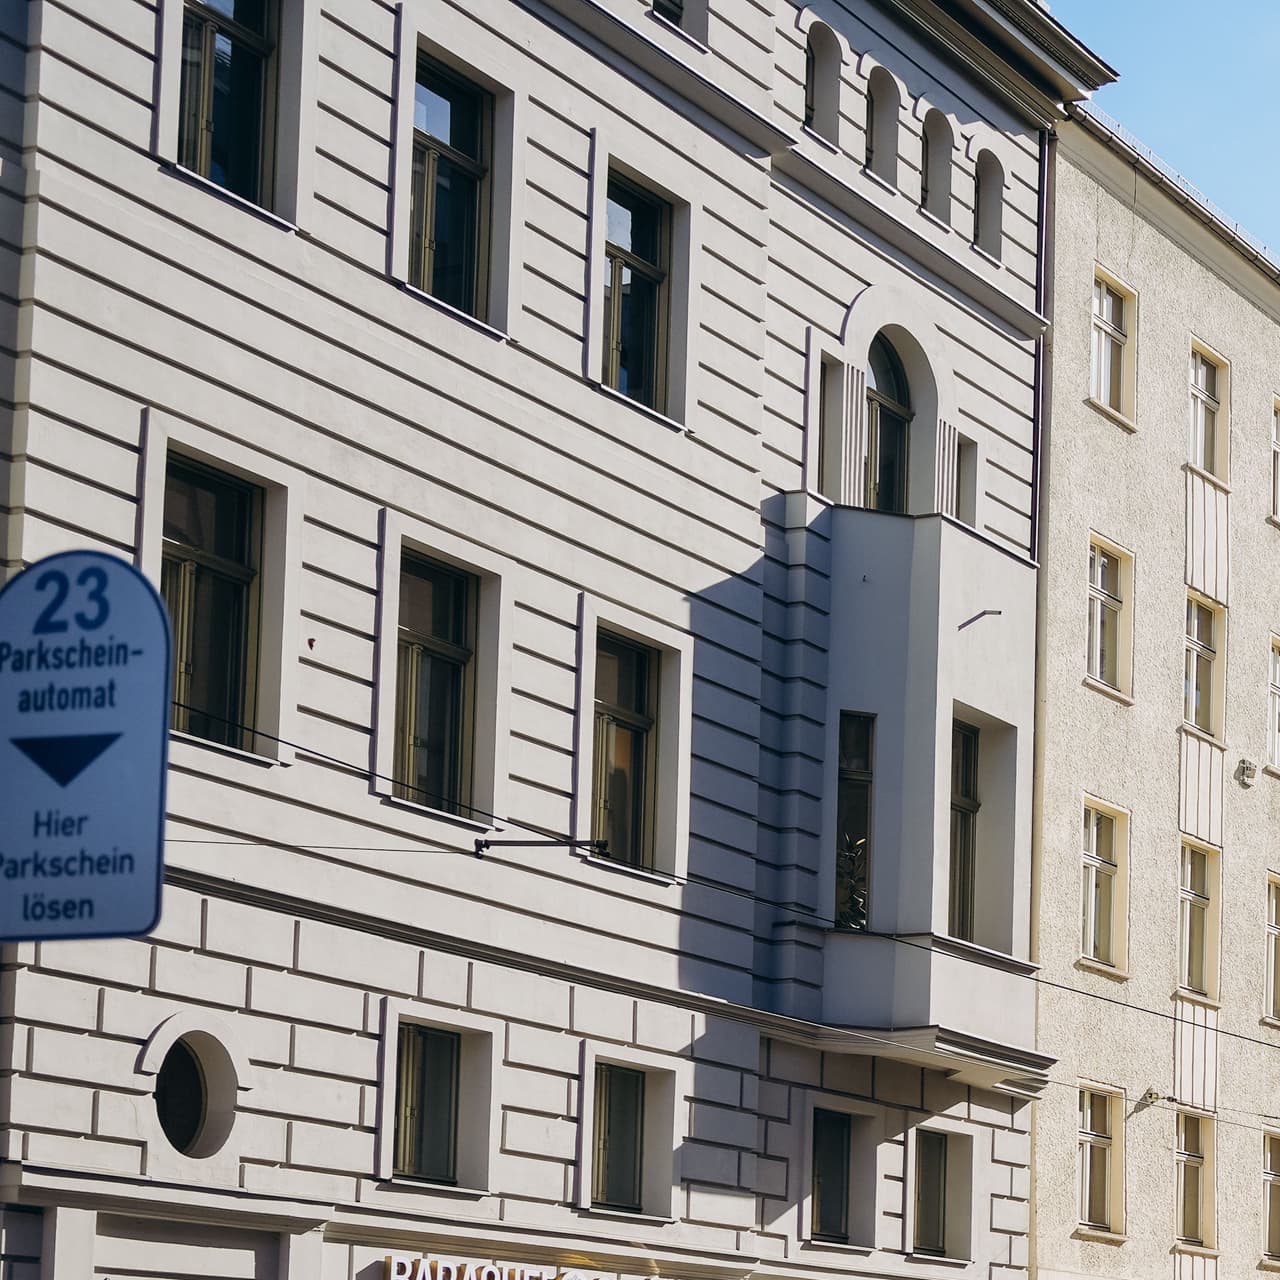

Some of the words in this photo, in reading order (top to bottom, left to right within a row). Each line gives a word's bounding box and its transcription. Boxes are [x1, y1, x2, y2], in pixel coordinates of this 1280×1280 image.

[32, 567, 111, 635] 23
[0, 636, 144, 673] Parkschein-
[18, 679, 117, 713] automat
[33, 811, 89, 839] Hier
[22, 895, 95, 923] lösen
